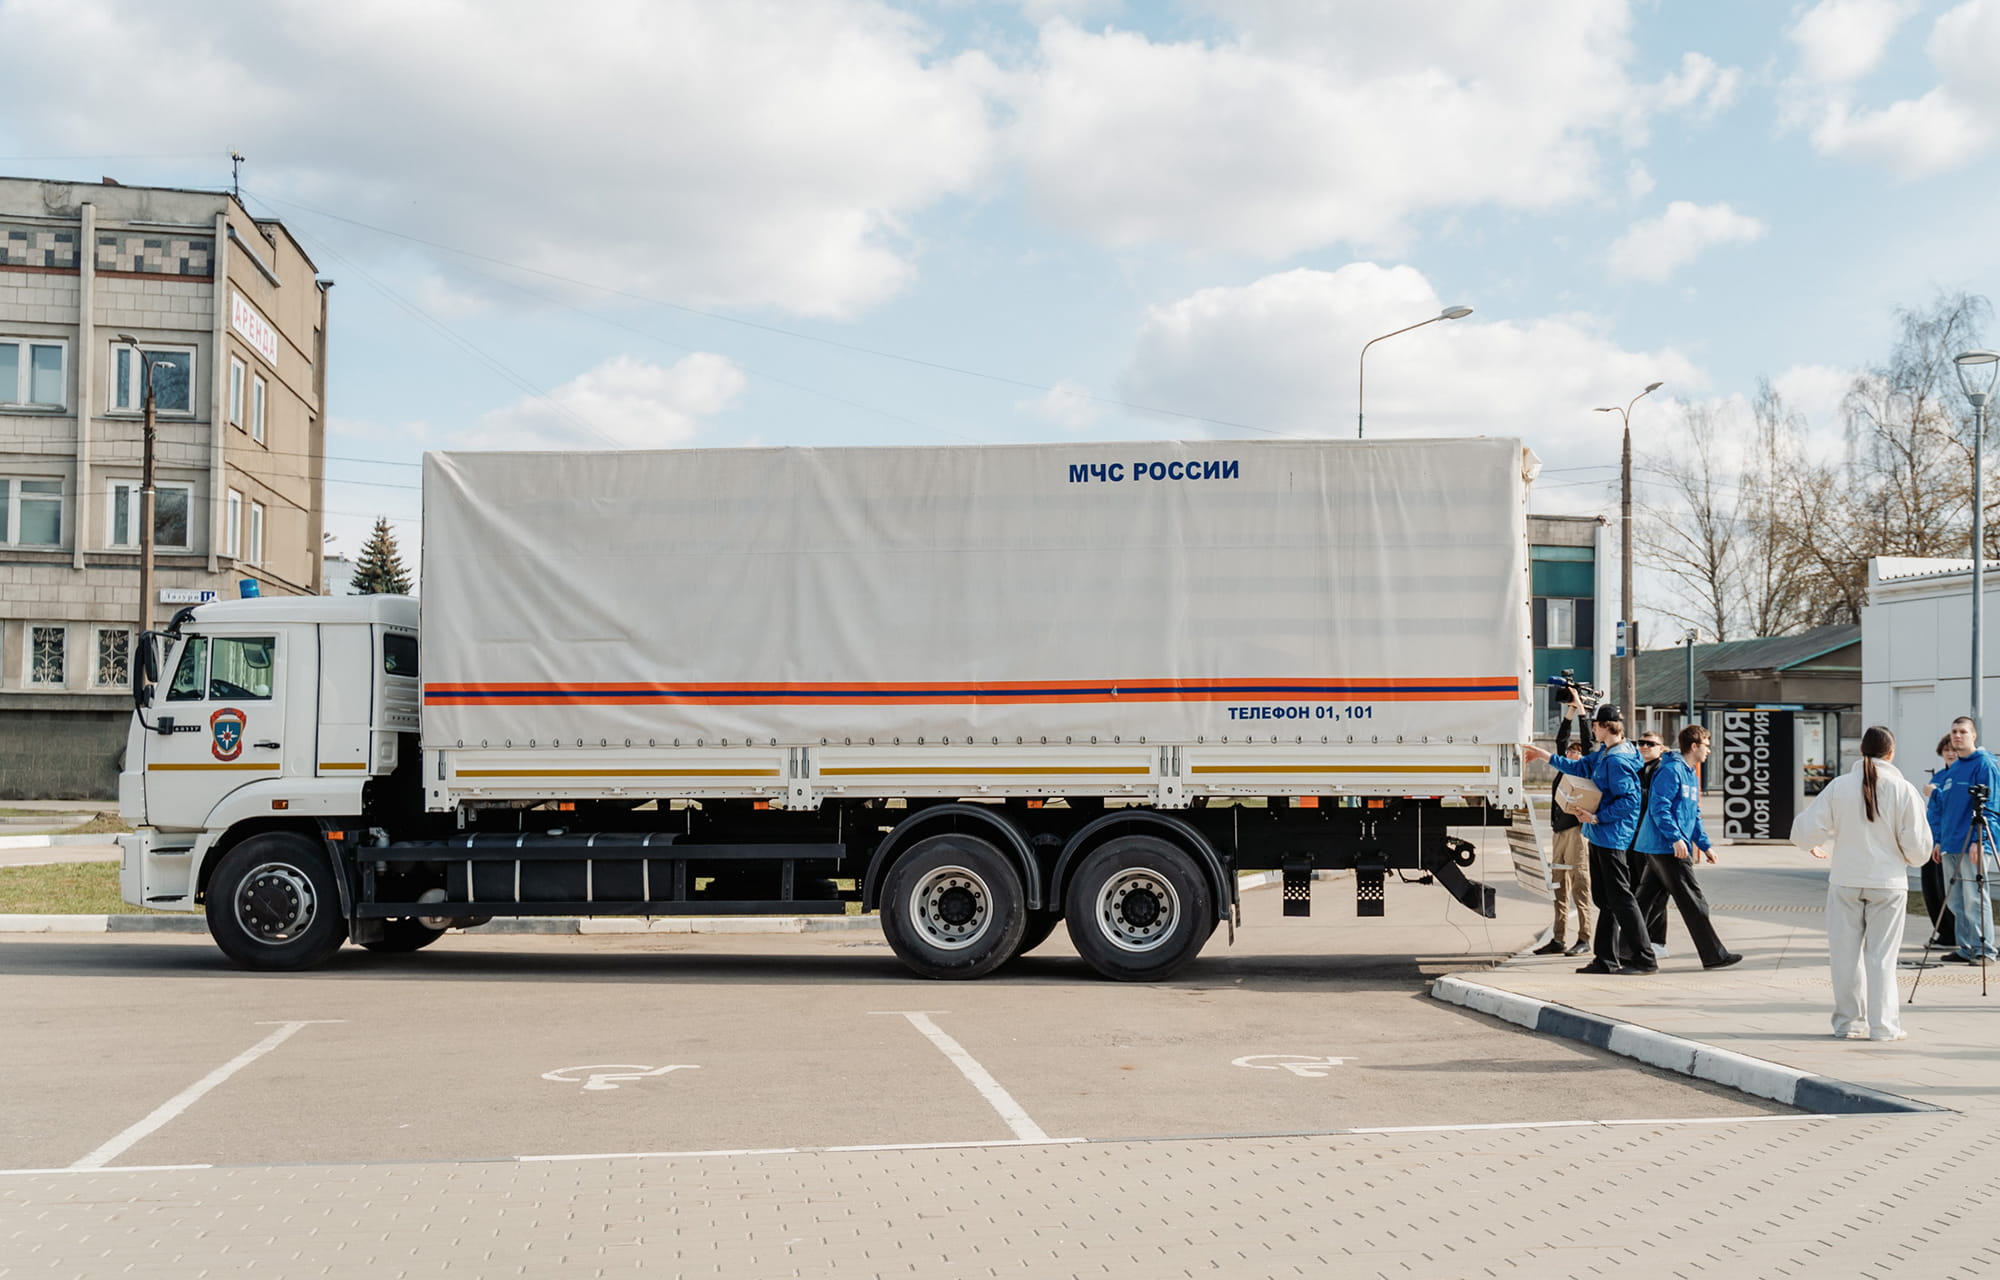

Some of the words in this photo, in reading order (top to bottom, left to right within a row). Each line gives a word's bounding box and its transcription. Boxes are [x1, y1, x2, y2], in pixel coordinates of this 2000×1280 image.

[234, 299, 275, 359] АРЕНДА
[1069, 463, 1124, 482] МЧС
[1133, 460, 1239, 481] РОССИИ
[1228, 706, 1310, 720] ТЕЛЕФОН
[1315, 706, 1340, 721] 01,
[1345, 706, 1372, 719] 101
[1724, 712, 1751, 839] РОССИЯ
[1754, 712, 1770, 795] ИСТОРИЯ
[1754, 799, 1770, 839] МОЯ
